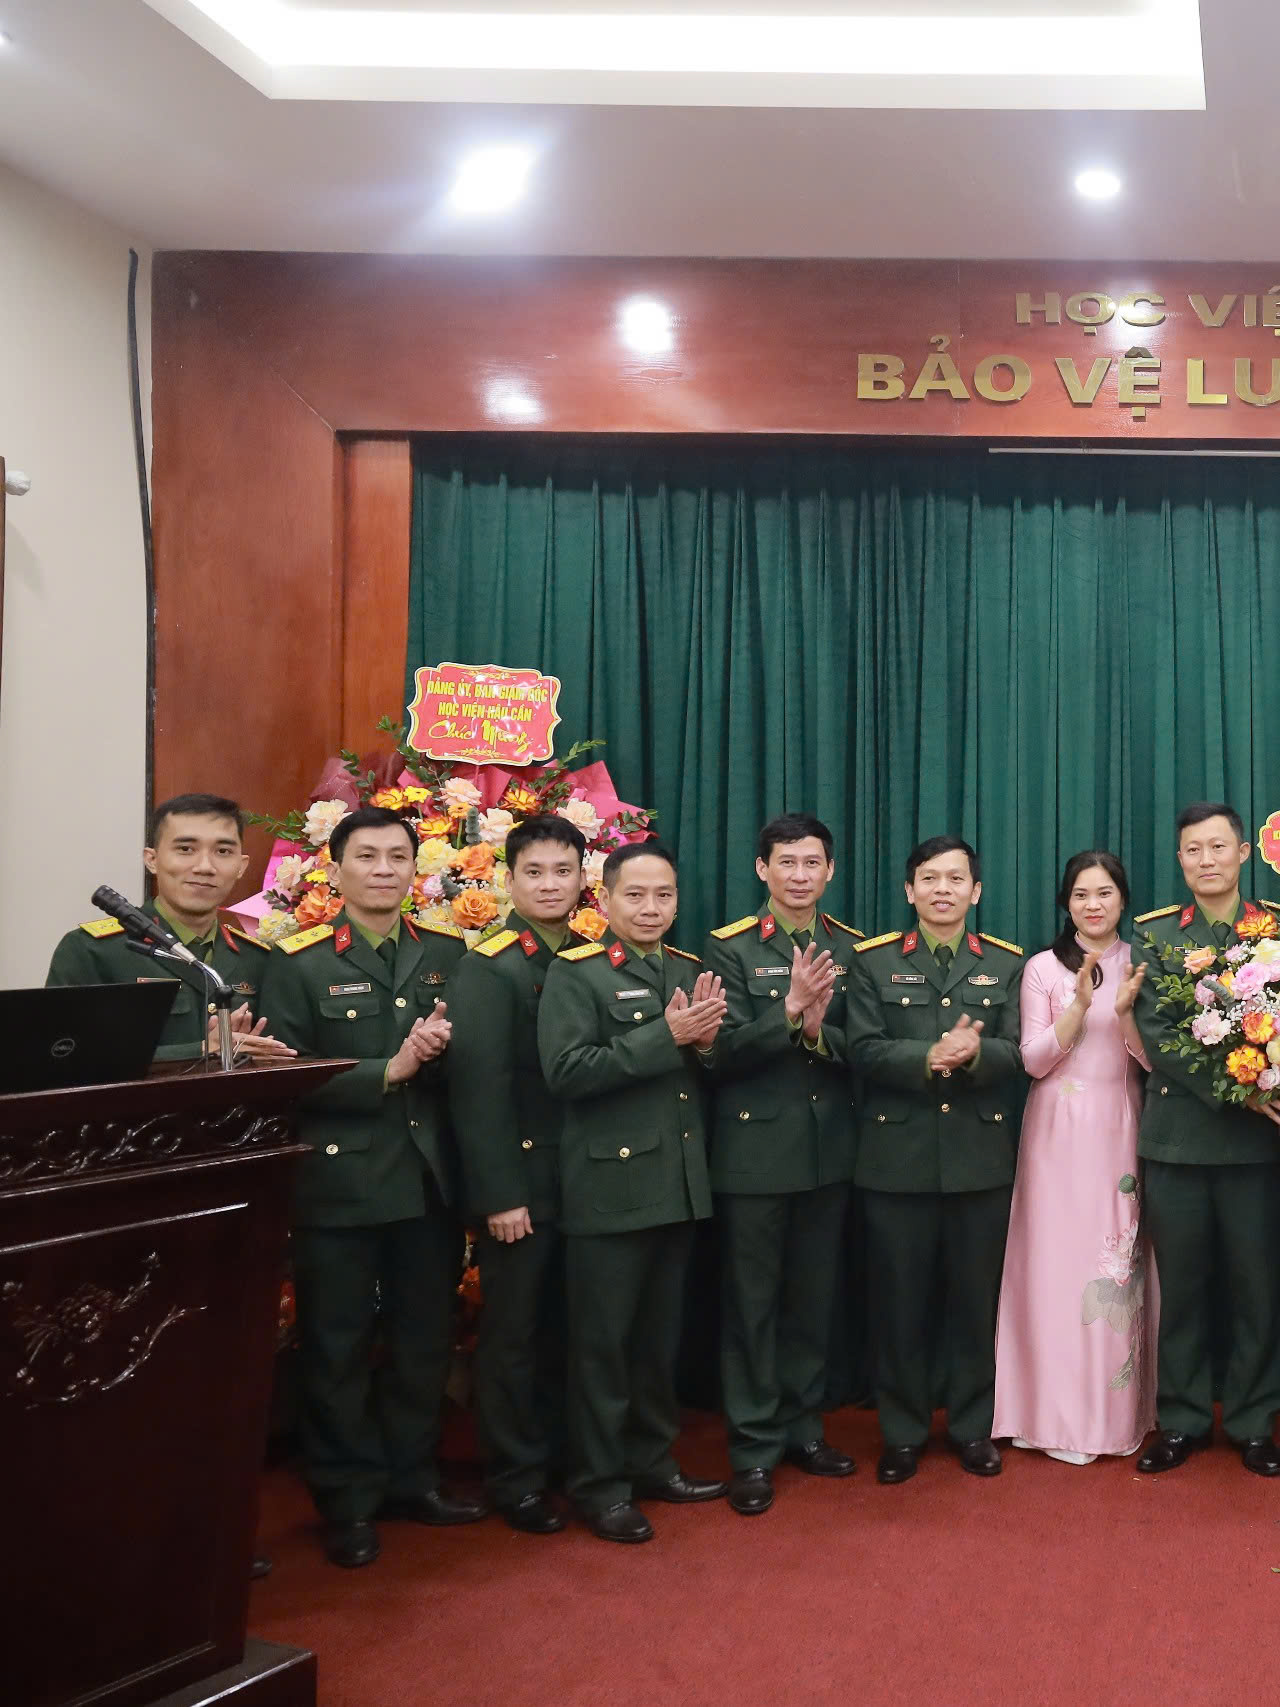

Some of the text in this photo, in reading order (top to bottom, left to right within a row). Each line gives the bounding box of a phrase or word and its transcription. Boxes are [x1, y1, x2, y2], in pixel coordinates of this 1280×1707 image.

[1015, 291, 1166, 336] HỌC
[857, 335, 1032, 402] BẢO
[1055, 346, 1162, 421] VỆ
[426, 677, 456, 696] ĐẢNG
[437, 702, 460, 719] HỌC
[461, 702, 486, 720] VIỆN
